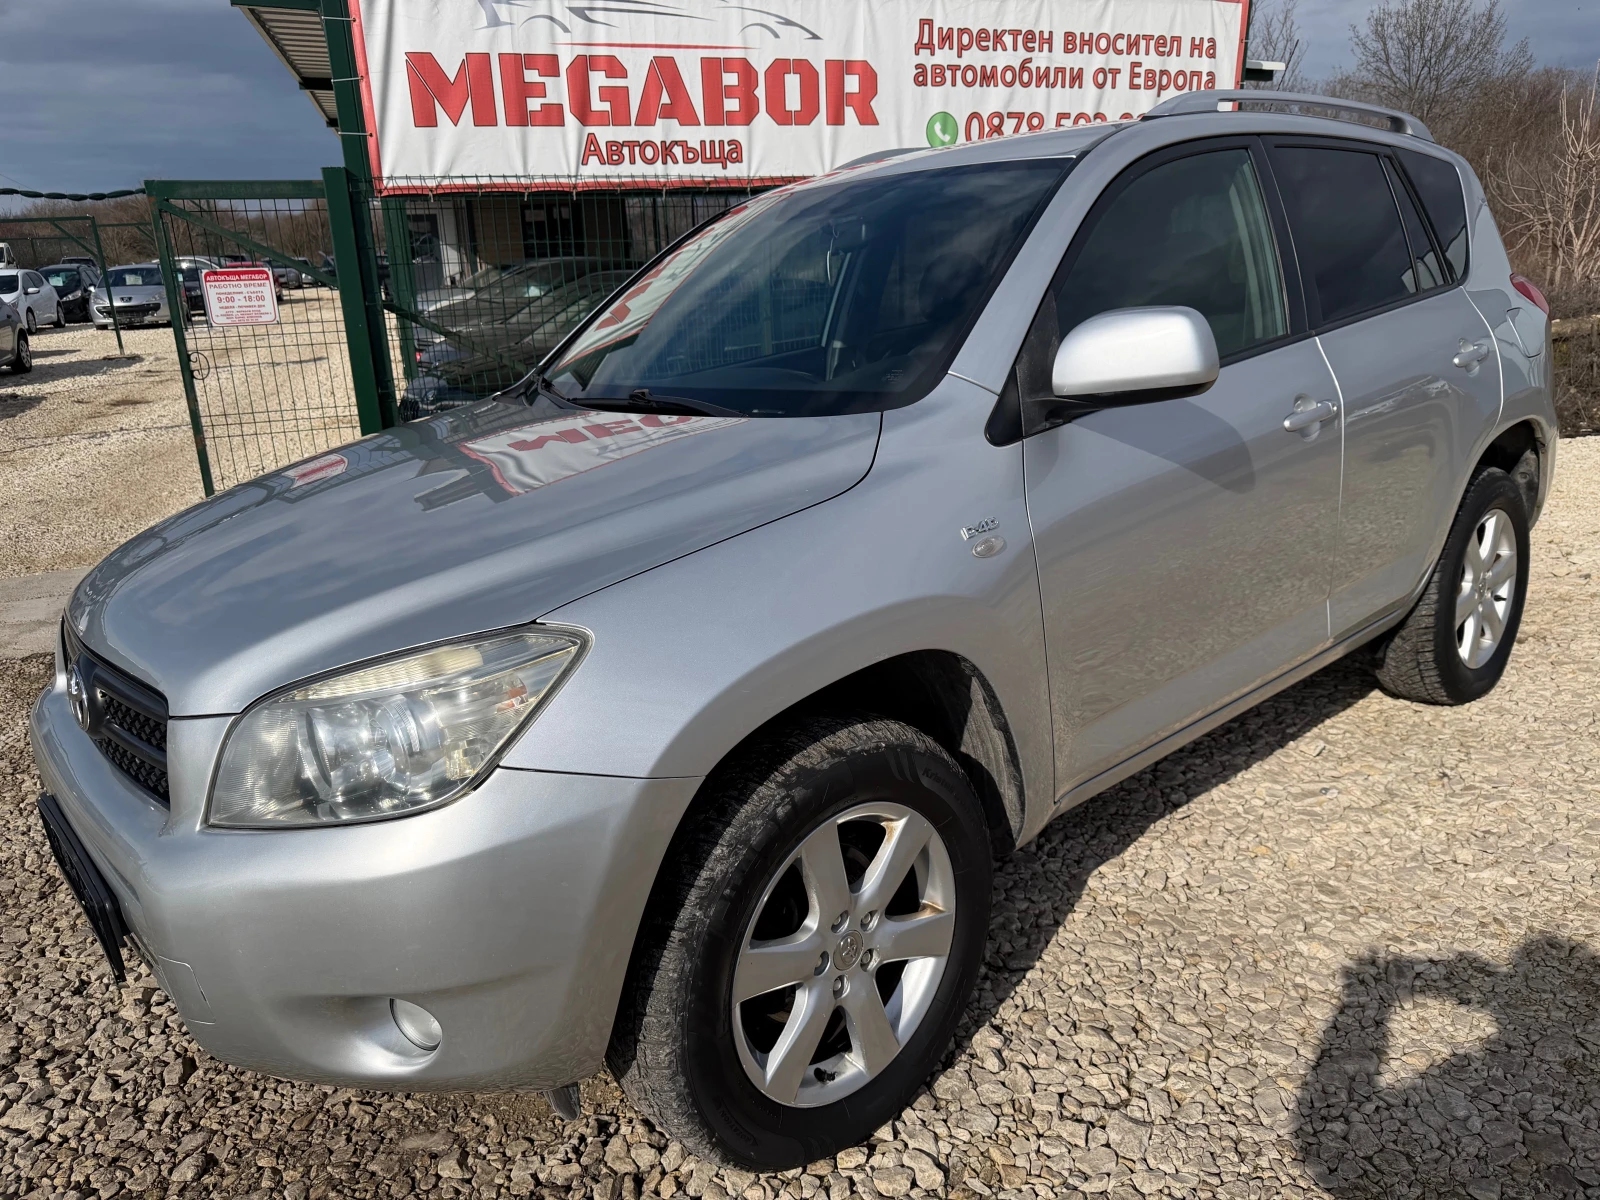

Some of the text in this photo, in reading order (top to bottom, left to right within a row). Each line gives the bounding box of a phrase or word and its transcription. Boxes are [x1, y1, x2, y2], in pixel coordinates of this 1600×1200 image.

[914, 18, 1217, 59] Директен вносител на
[405, 52, 879, 127] MEGABOR
[913, 57, 1216, 97] автомобили от Европа
[581, 133, 743, 169] Автокъща
[216, 295, 236, 303] 9:00
